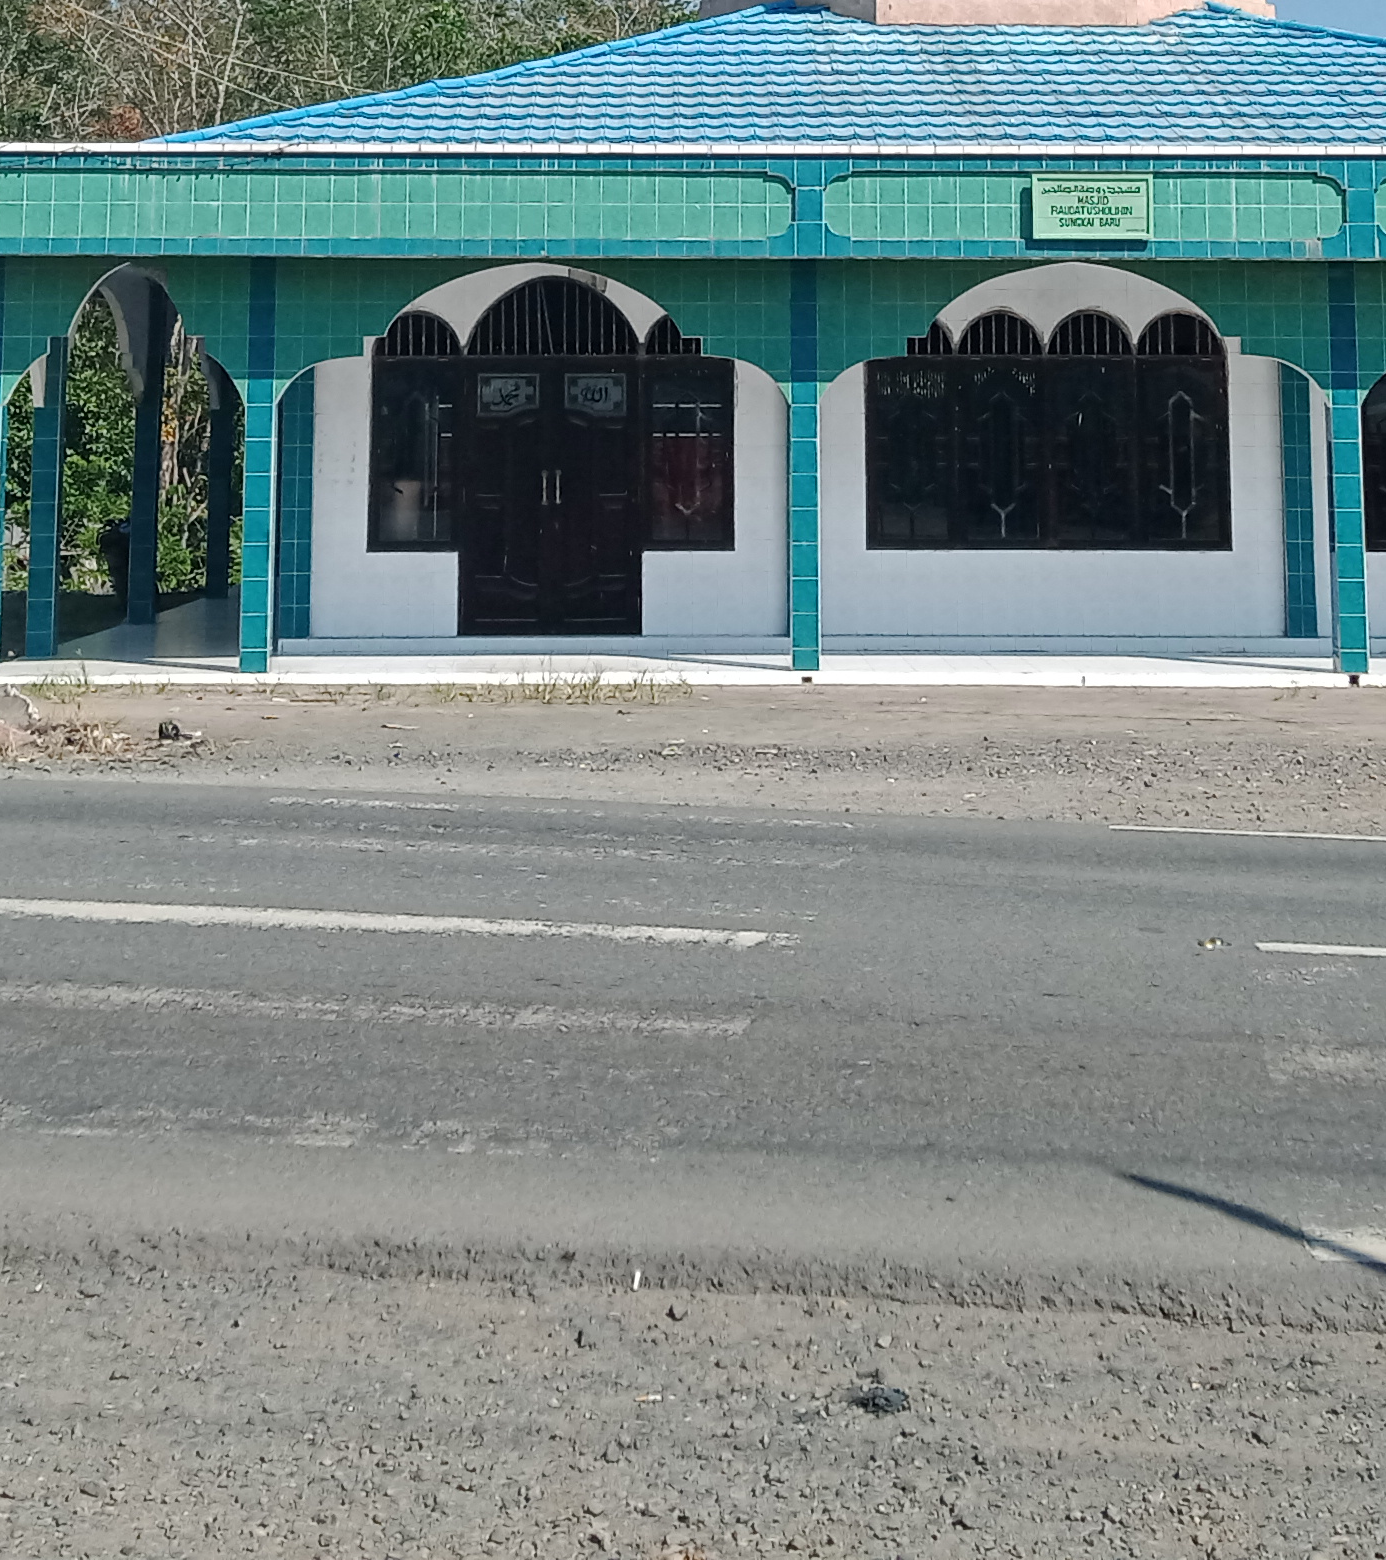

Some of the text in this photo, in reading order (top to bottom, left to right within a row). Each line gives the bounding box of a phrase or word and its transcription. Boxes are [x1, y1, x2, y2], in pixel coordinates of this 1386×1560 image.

[1078, 195, 1110, 205] MASJID
[1058, 217, 1121, 228] SUNGKAI BARU
